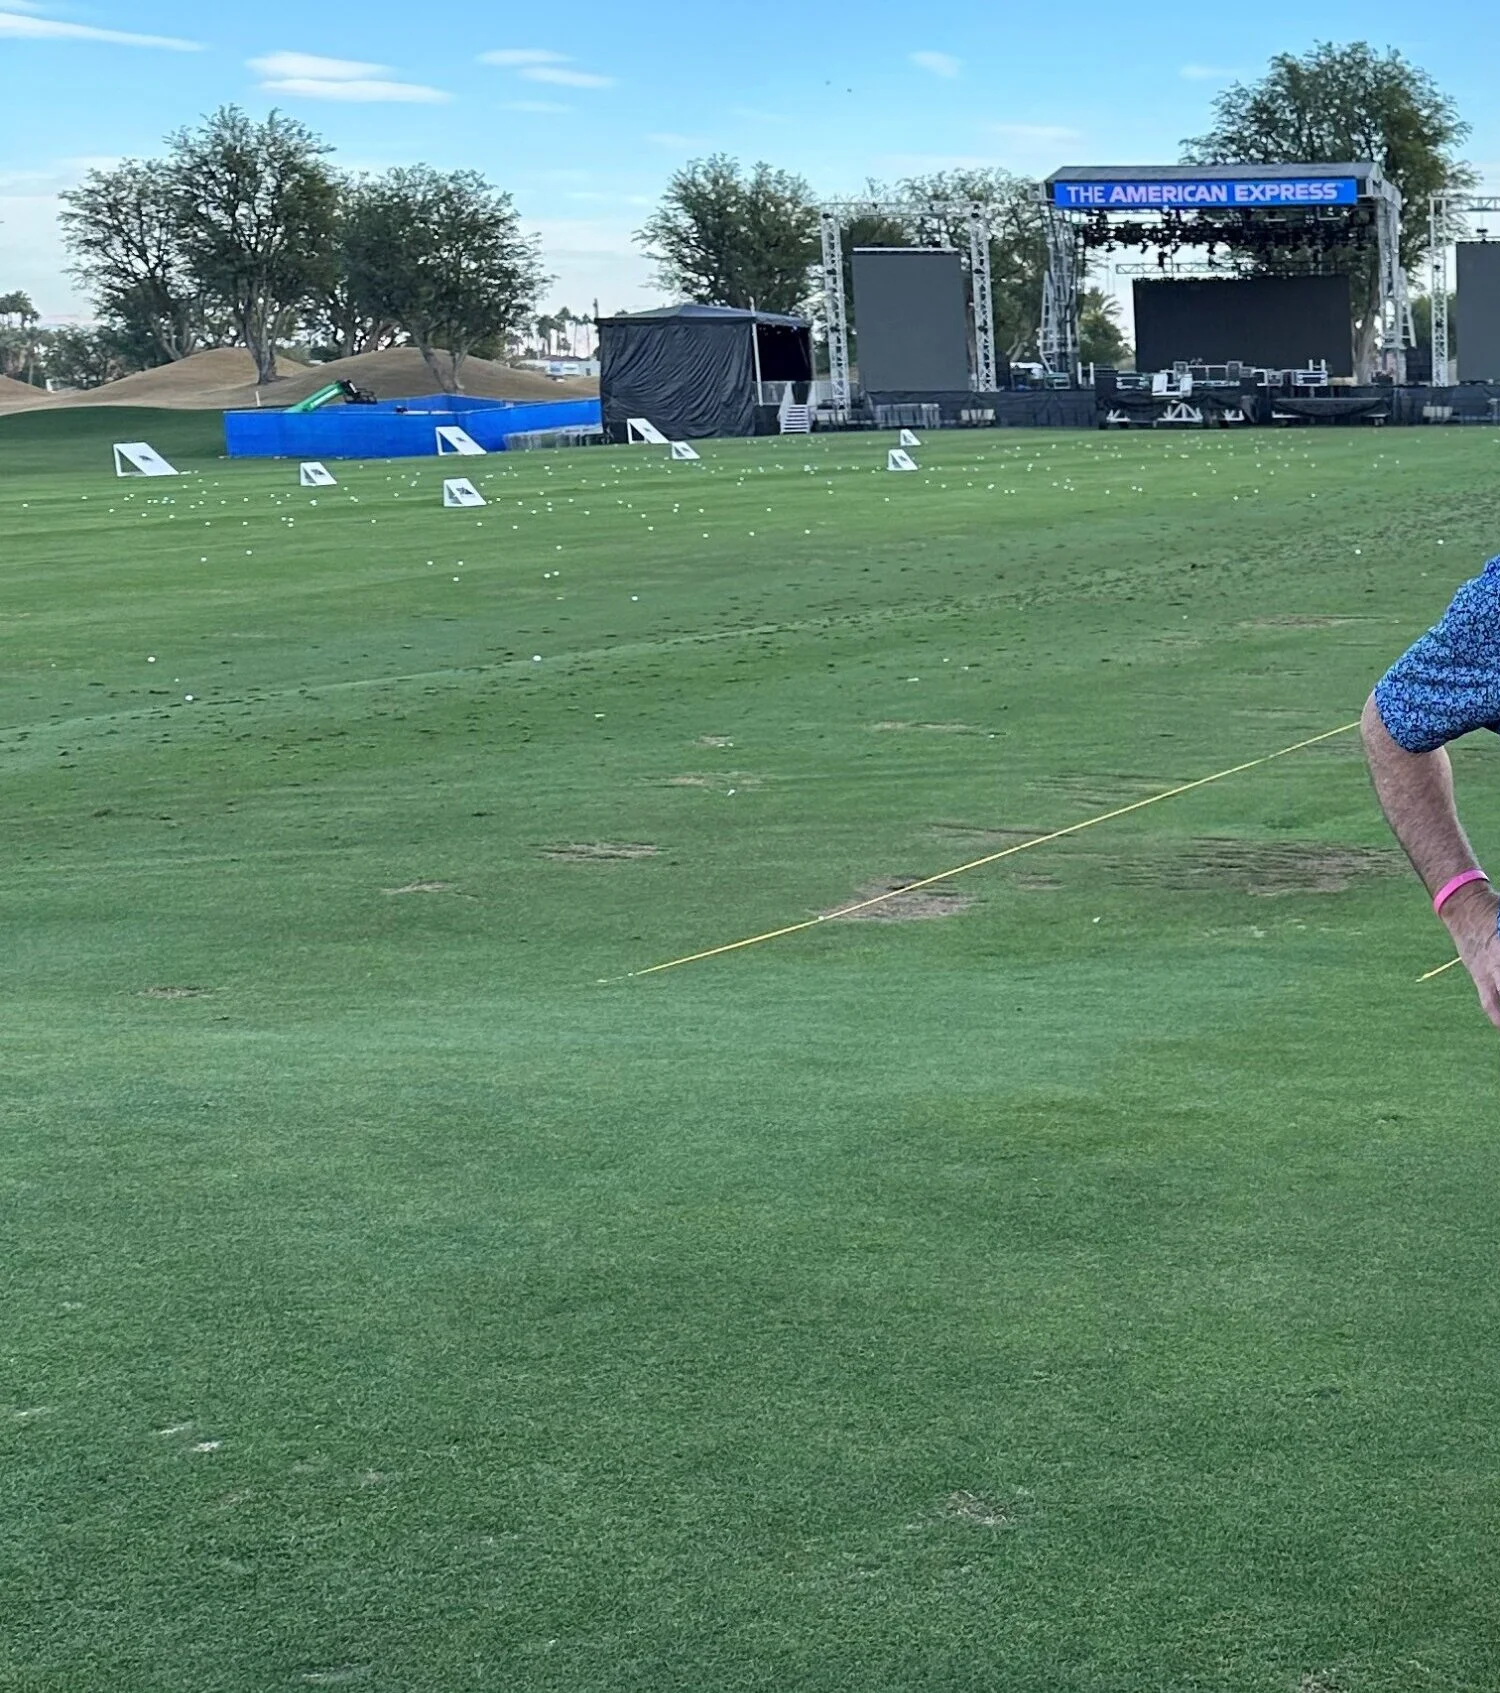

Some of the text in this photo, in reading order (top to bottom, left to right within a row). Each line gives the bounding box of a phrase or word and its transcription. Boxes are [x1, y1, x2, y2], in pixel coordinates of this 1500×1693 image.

[1067, 183, 1338, 203] THE AMERICAN EXPRESS
